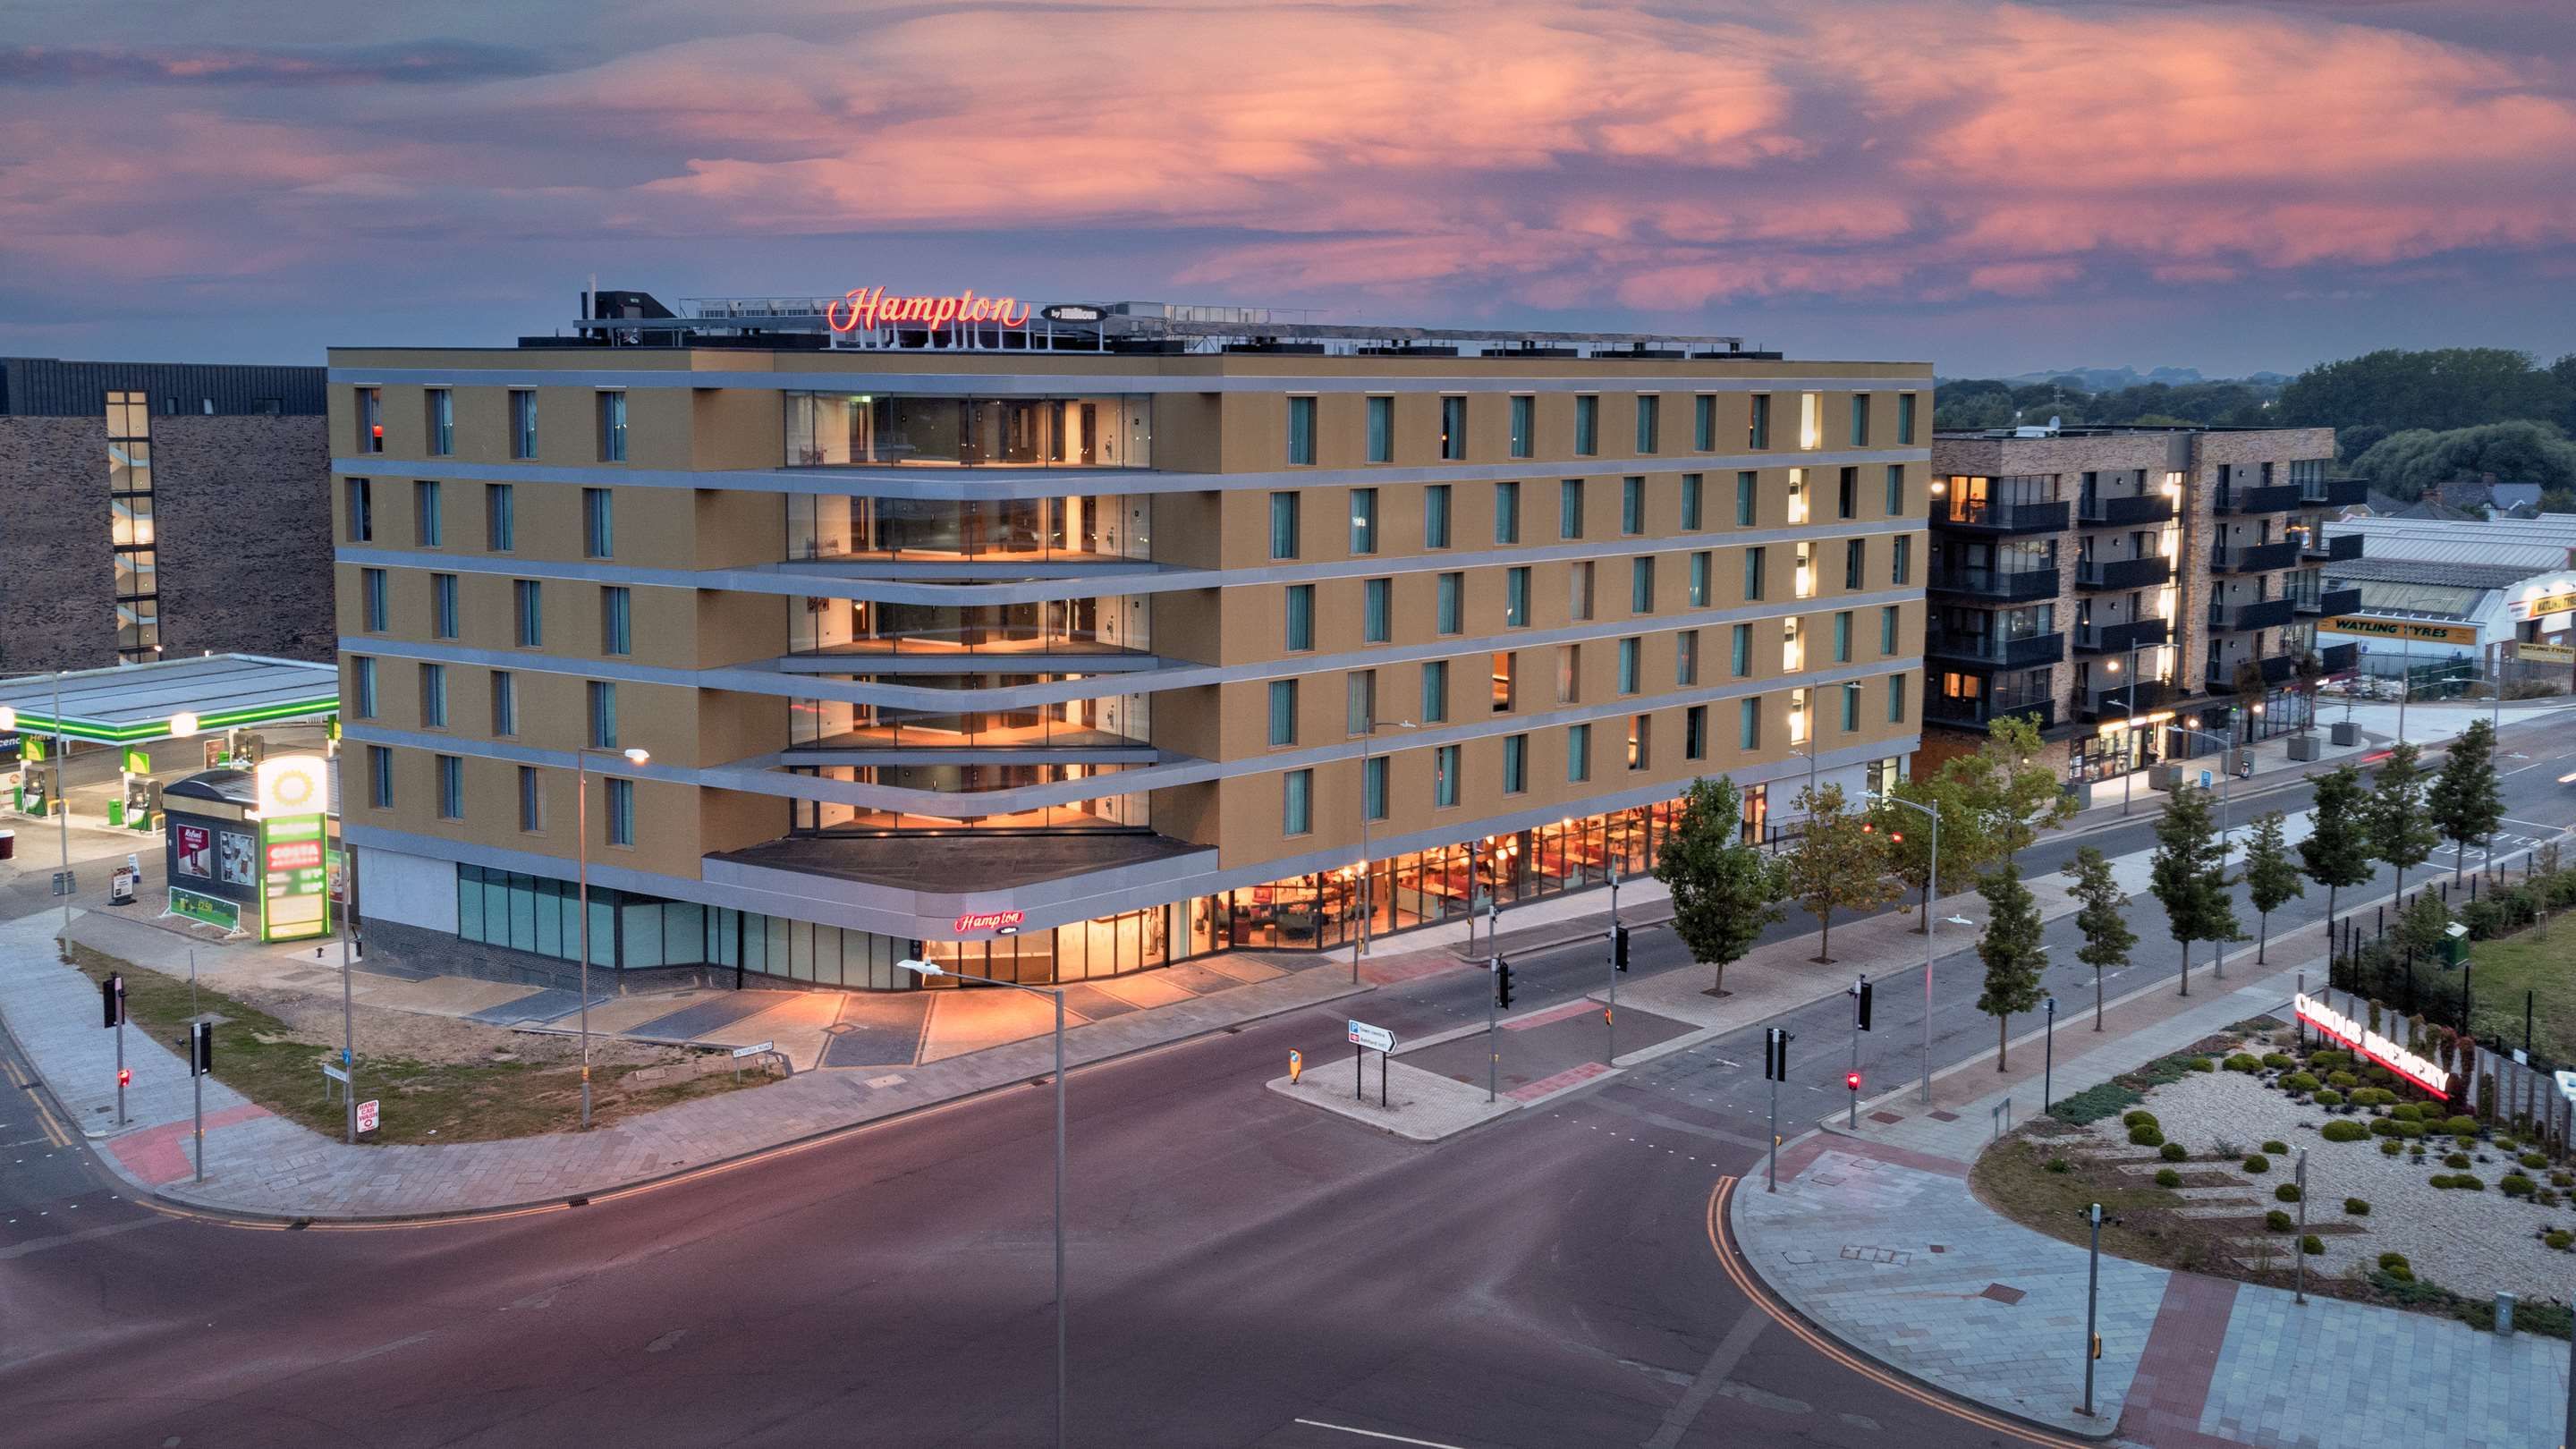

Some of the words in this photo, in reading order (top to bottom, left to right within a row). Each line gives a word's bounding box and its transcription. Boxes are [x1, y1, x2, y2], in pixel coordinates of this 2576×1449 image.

[828, 285, 1030, 332] Hampton
[2335, 619, 2398, 634] WATLING
[2403, 625, 2447, 639] TYRES
[954, 911, 1024, 933] Hampton
[360, 1101, 377, 1110] HAND
[359, 1112, 378, 1122] WASH
